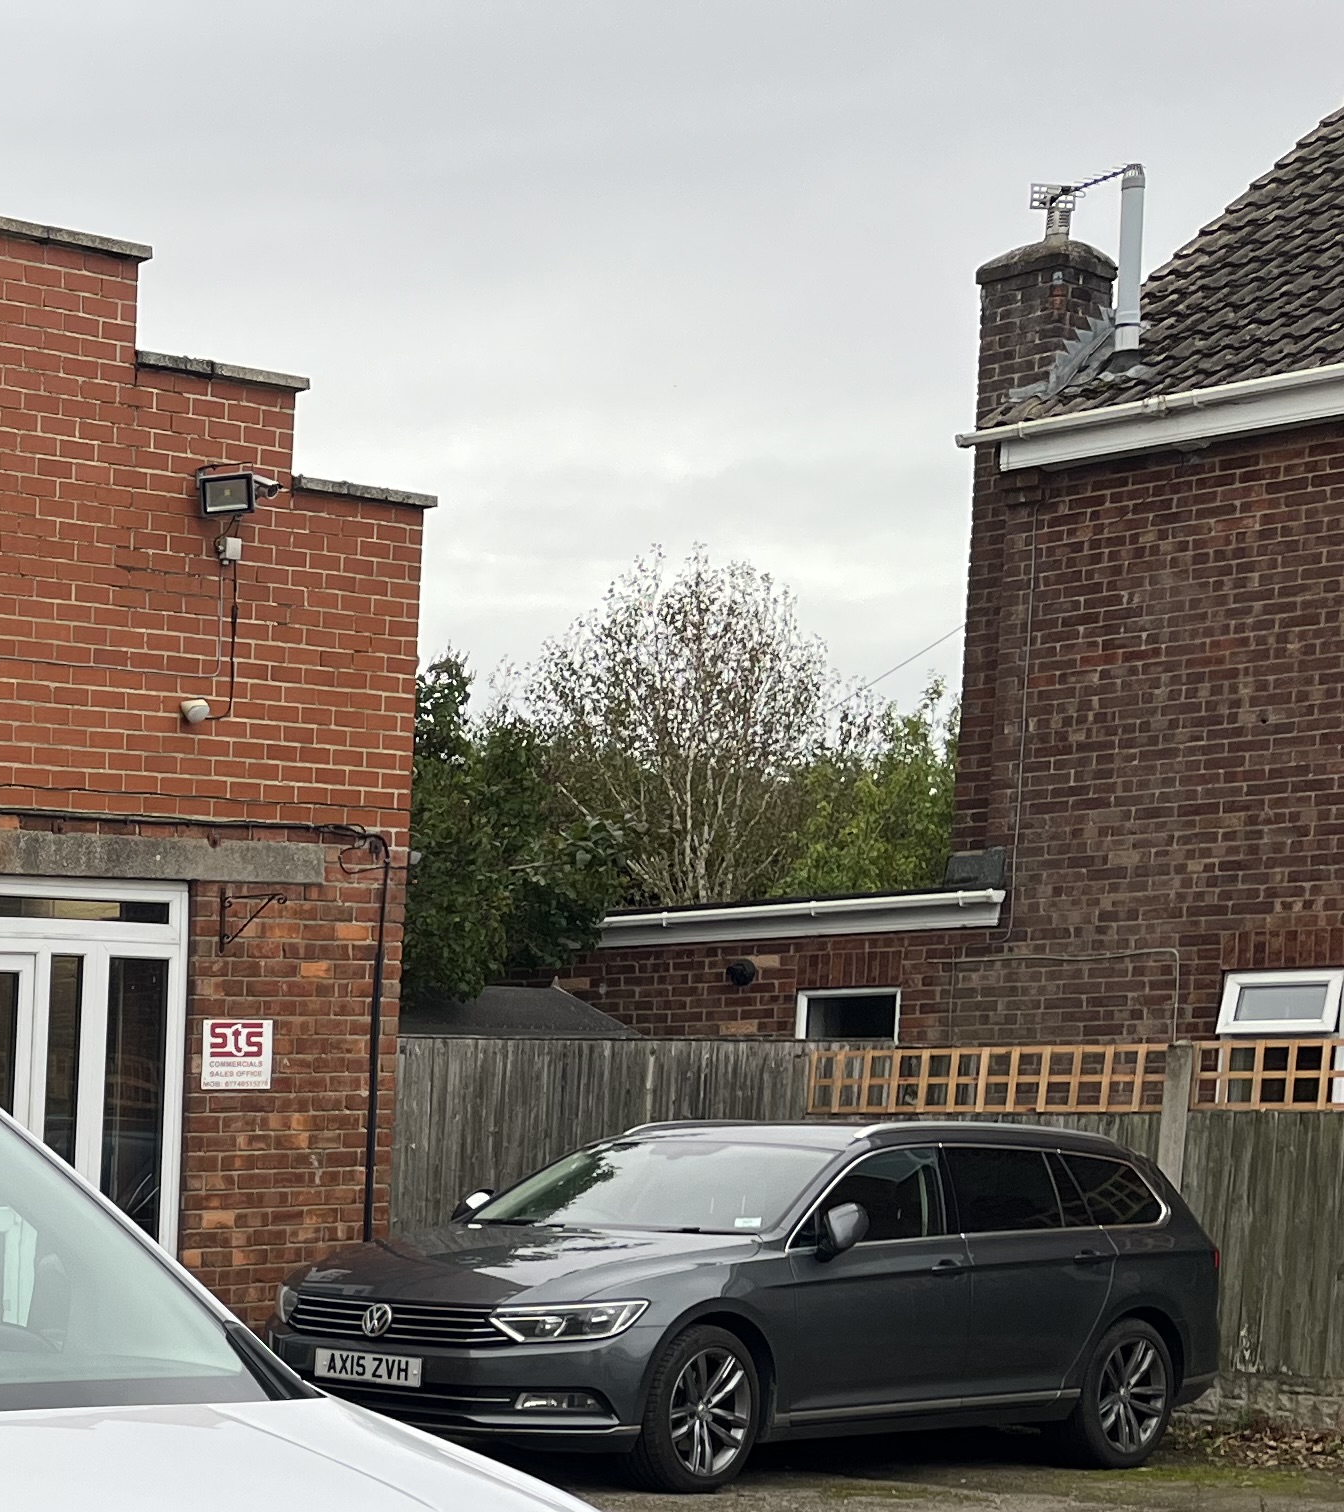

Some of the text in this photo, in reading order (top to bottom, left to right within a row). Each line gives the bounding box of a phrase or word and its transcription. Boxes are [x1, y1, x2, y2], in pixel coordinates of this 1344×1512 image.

[209, 1060, 263, 1068] COMMERCIALS
[327, 1352, 410, 1381] AX15 ZVH
